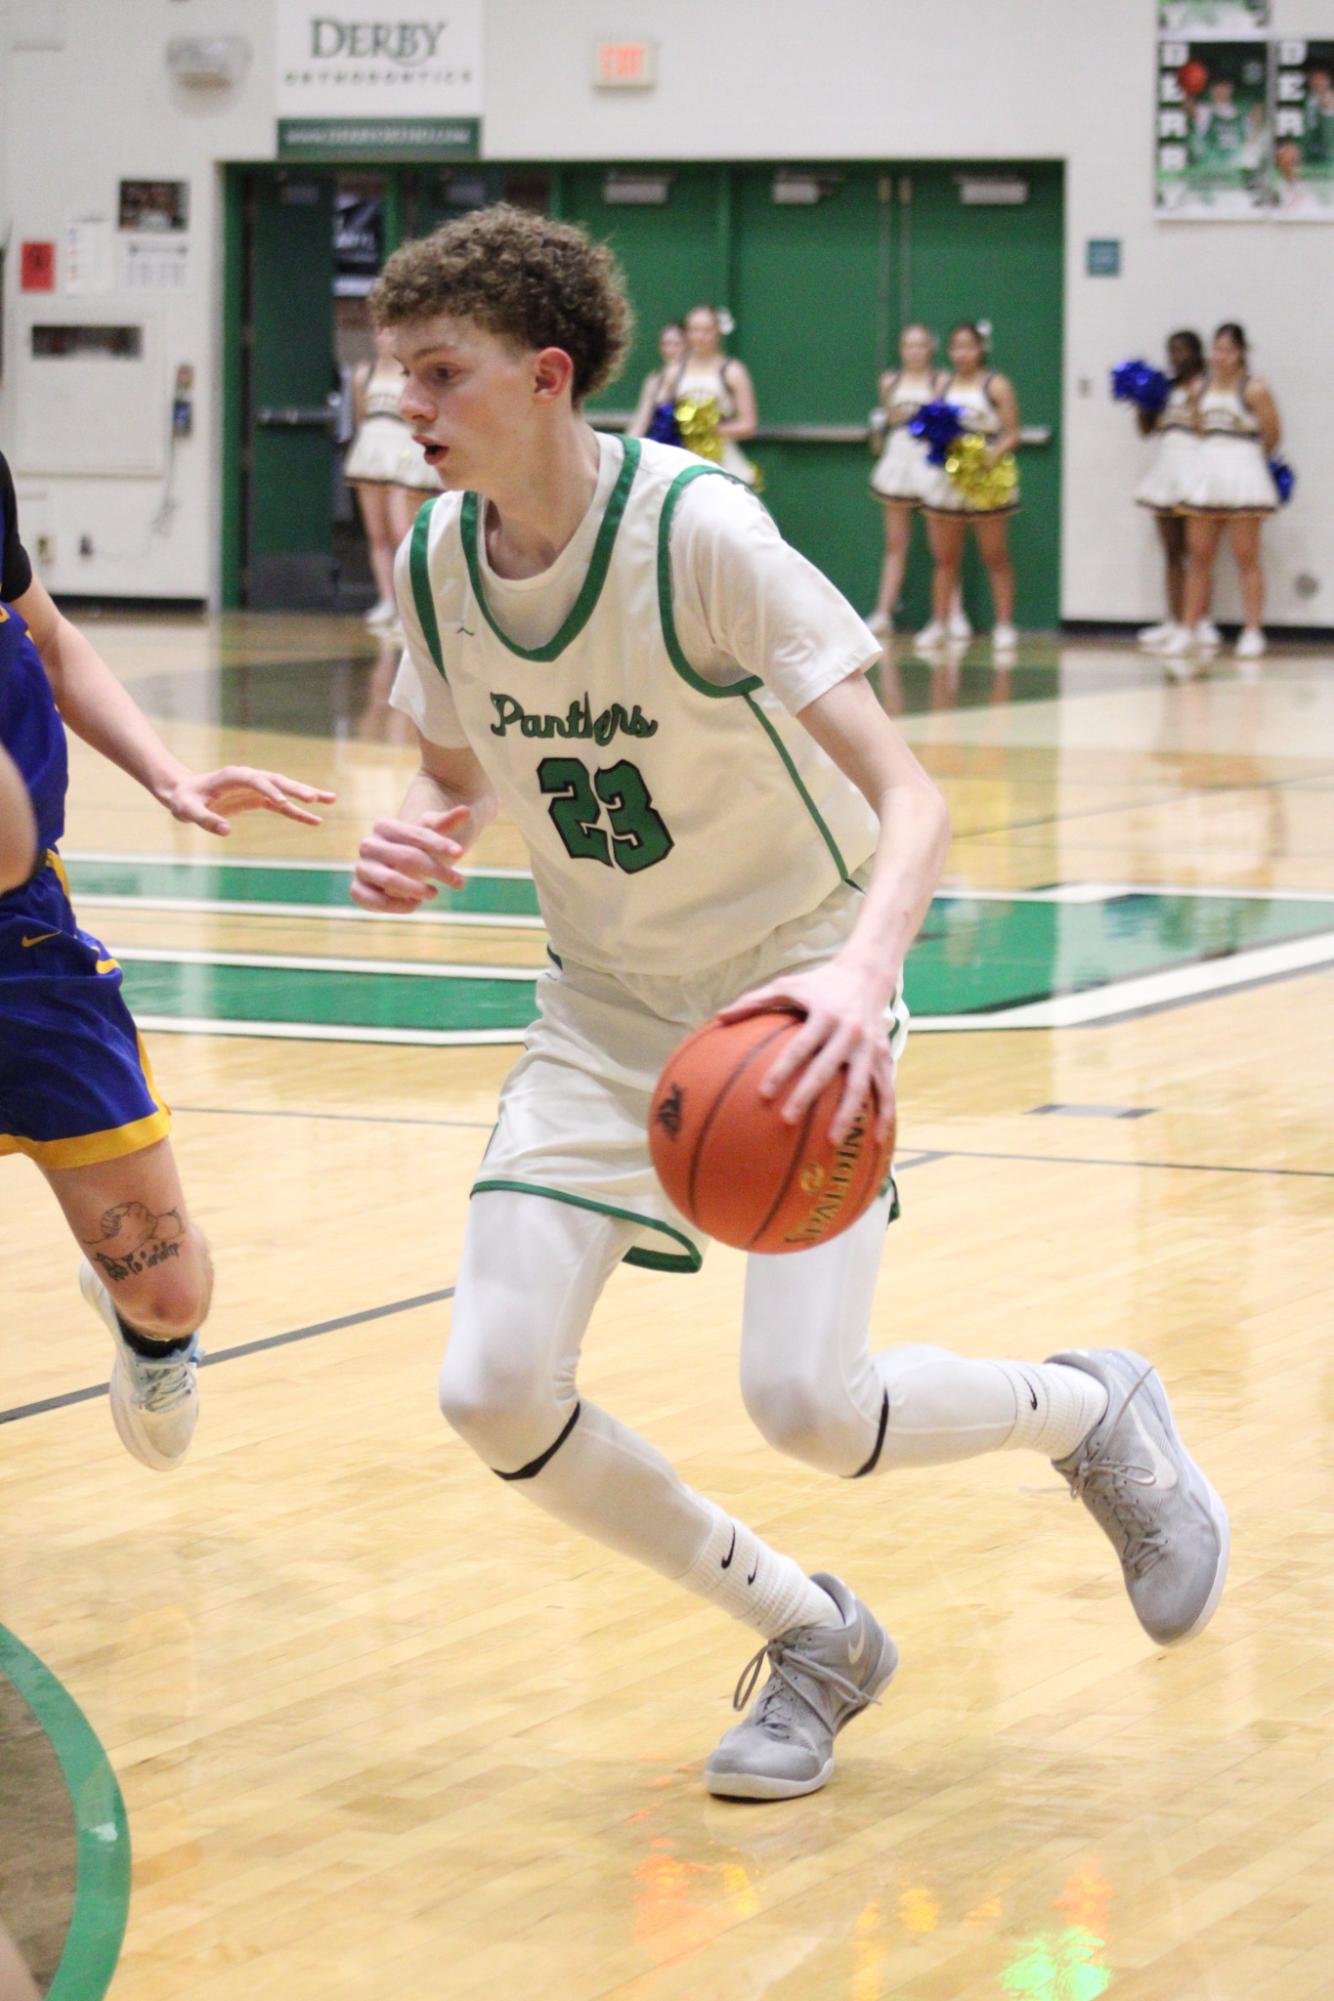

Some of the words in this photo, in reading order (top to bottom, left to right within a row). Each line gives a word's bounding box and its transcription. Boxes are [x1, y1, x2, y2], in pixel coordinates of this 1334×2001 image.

[311, 18, 445, 65] DERBY
[600, 44, 643, 79] EXIT
[536, 757, 674, 874] 23
